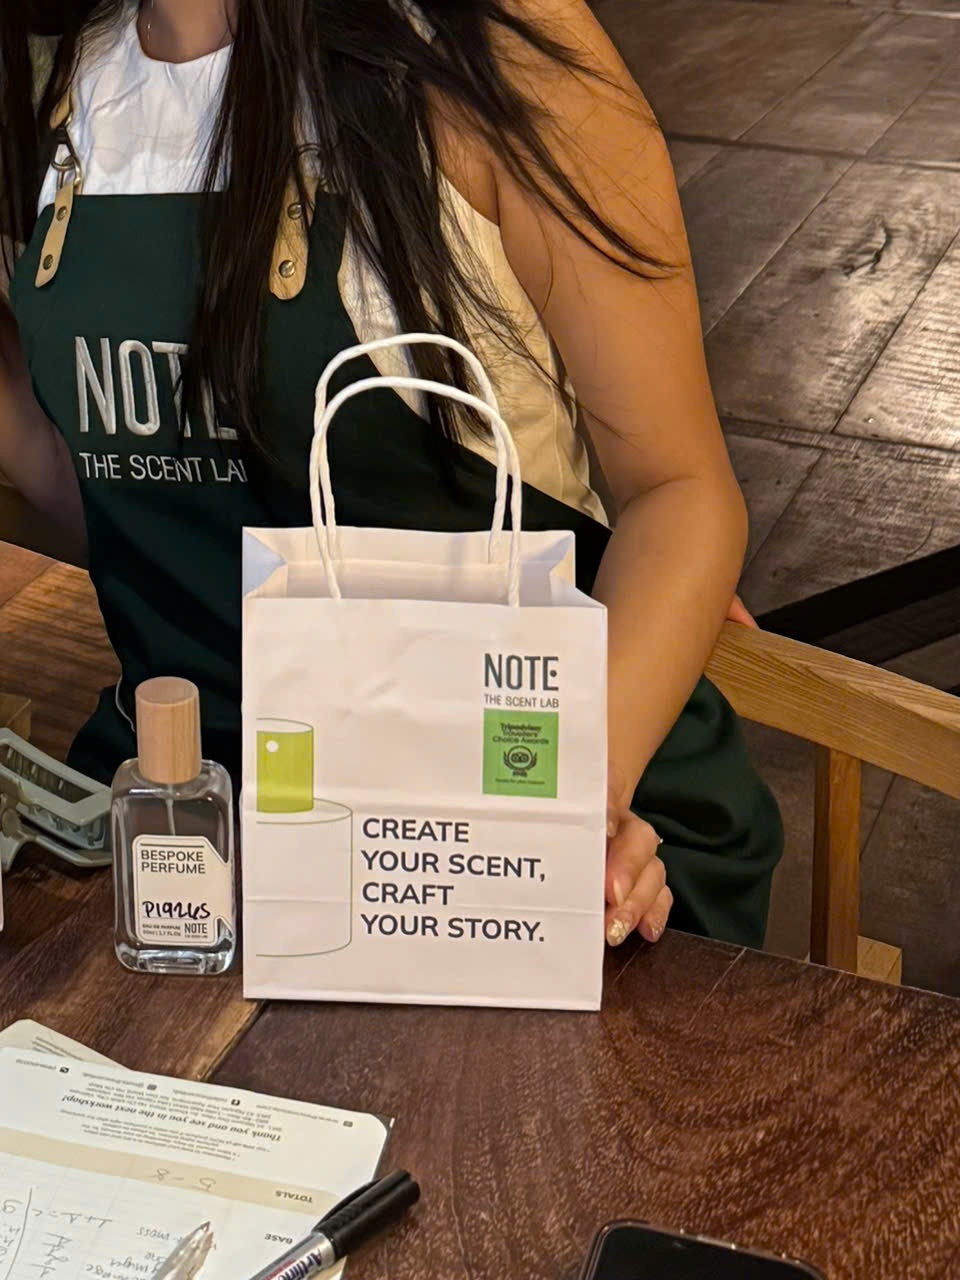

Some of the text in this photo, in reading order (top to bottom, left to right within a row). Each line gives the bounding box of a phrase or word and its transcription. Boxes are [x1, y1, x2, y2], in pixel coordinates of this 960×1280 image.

[80, 453, 247, 483] THE SCENT LA
[484, 653, 559, 691] NOTE
[484, 694, 559, 708] THE SCENT LAB
[492, 736, 519, 744] Choice
[362, 818, 470, 843] CREATE
[141, 850, 204, 862] BESPOKE
[361, 850, 546, 881] YOUR SCENT,
[141, 862, 206, 874] PERFUME
[362, 882, 454, 906] CRAFT
[184, 922, 208, 934] NOTE
[360, 914, 545, 942] YOUR STORY.
[62, 1094, 281, 1142] Thank you and see you in the next workshop!
[275, 1190, 313, 1203] TOTALS
[264, 1233, 293, 1245] BASE
